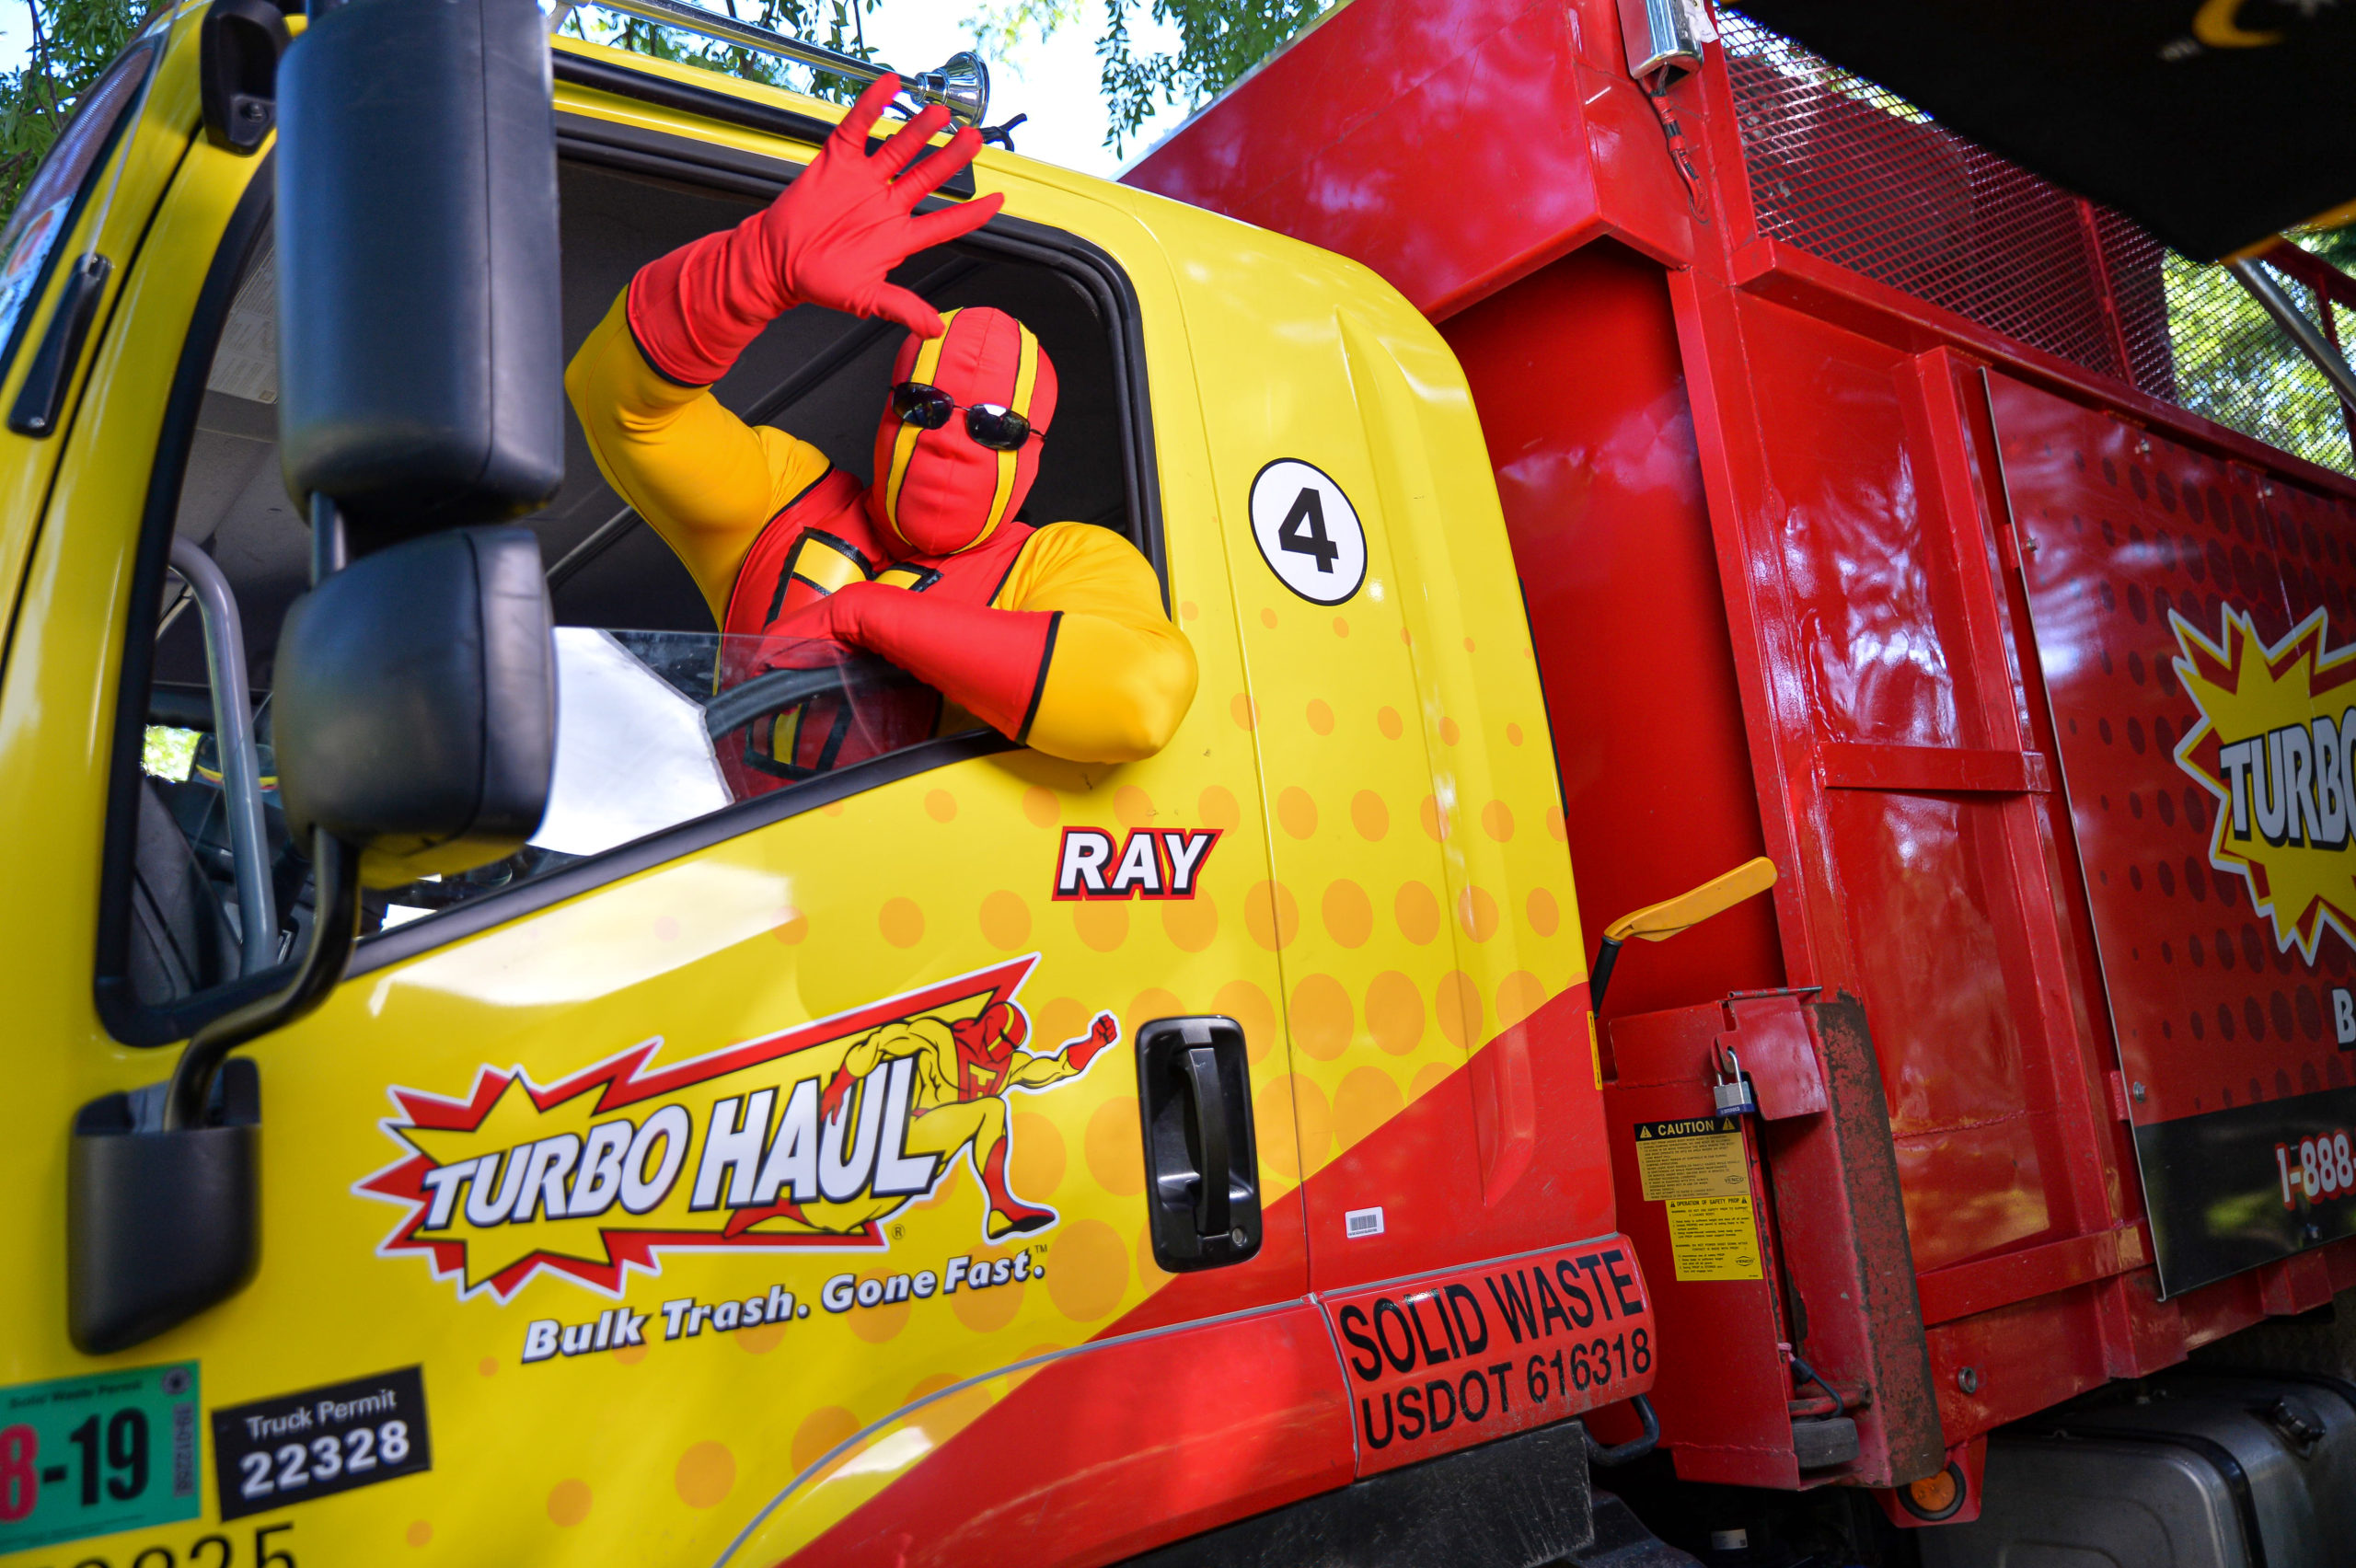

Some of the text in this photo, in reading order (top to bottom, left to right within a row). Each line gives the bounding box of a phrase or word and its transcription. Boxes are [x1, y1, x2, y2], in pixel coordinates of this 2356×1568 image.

[1278, 487, 1339, 574] 4
[1055, 829, 1219, 897] RAY
[422, 1055, 943, 1230] TURBO HAUL
[1657, 1120, 1715, 1136] CAUTION
[521, 1305, 646, 1364] Bulk
[661, 1284, 809, 1341] Trash.
[820, 1267, 937, 1315] Gone
[944, 1248, 1046, 1295] Fast.
[1339, 1250, 1644, 1382] SOLID WASTE
[246, 1389, 396, 1441] Truck Permit
[1362, 1328, 1651, 1449] USDOT 616318
[239, 1420, 410, 1502] 22328
